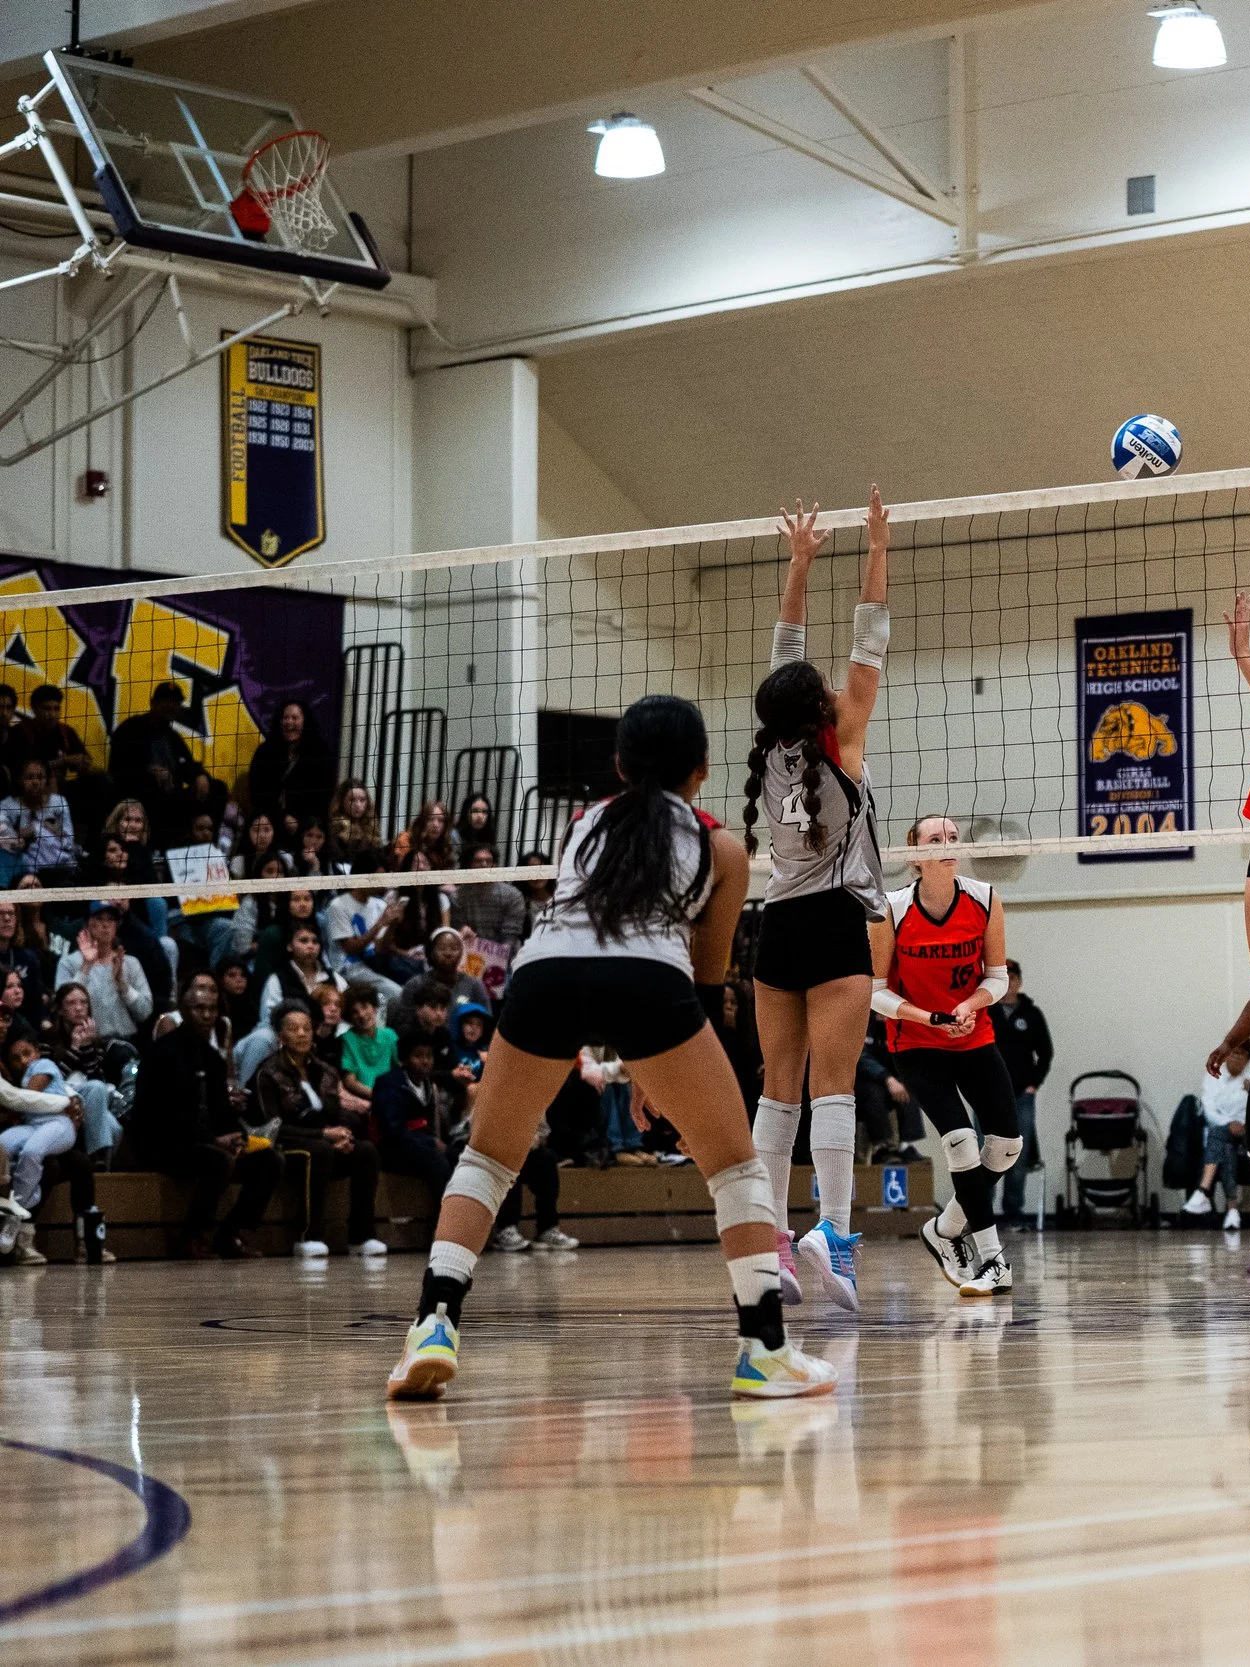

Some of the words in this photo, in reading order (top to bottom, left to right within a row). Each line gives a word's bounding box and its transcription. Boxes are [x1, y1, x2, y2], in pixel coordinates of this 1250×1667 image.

[248, 361, 314, 389] BULLDOGS
[231, 386, 245, 481] FOOTBALL
[1129, 438, 1162, 468] molten
[1094, 642, 1174, 661] OAKLAND
[1086, 658, 1181, 677] TECHNICAL
[1086, 681, 1122, 695] HIGH
[1124, 677, 1180, 693] SCHOOL
[1096, 776, 1171, 791] BASKETBALL
[778, 782, 813, 833] 4
[1091, 811, 1178, 837] 2004
